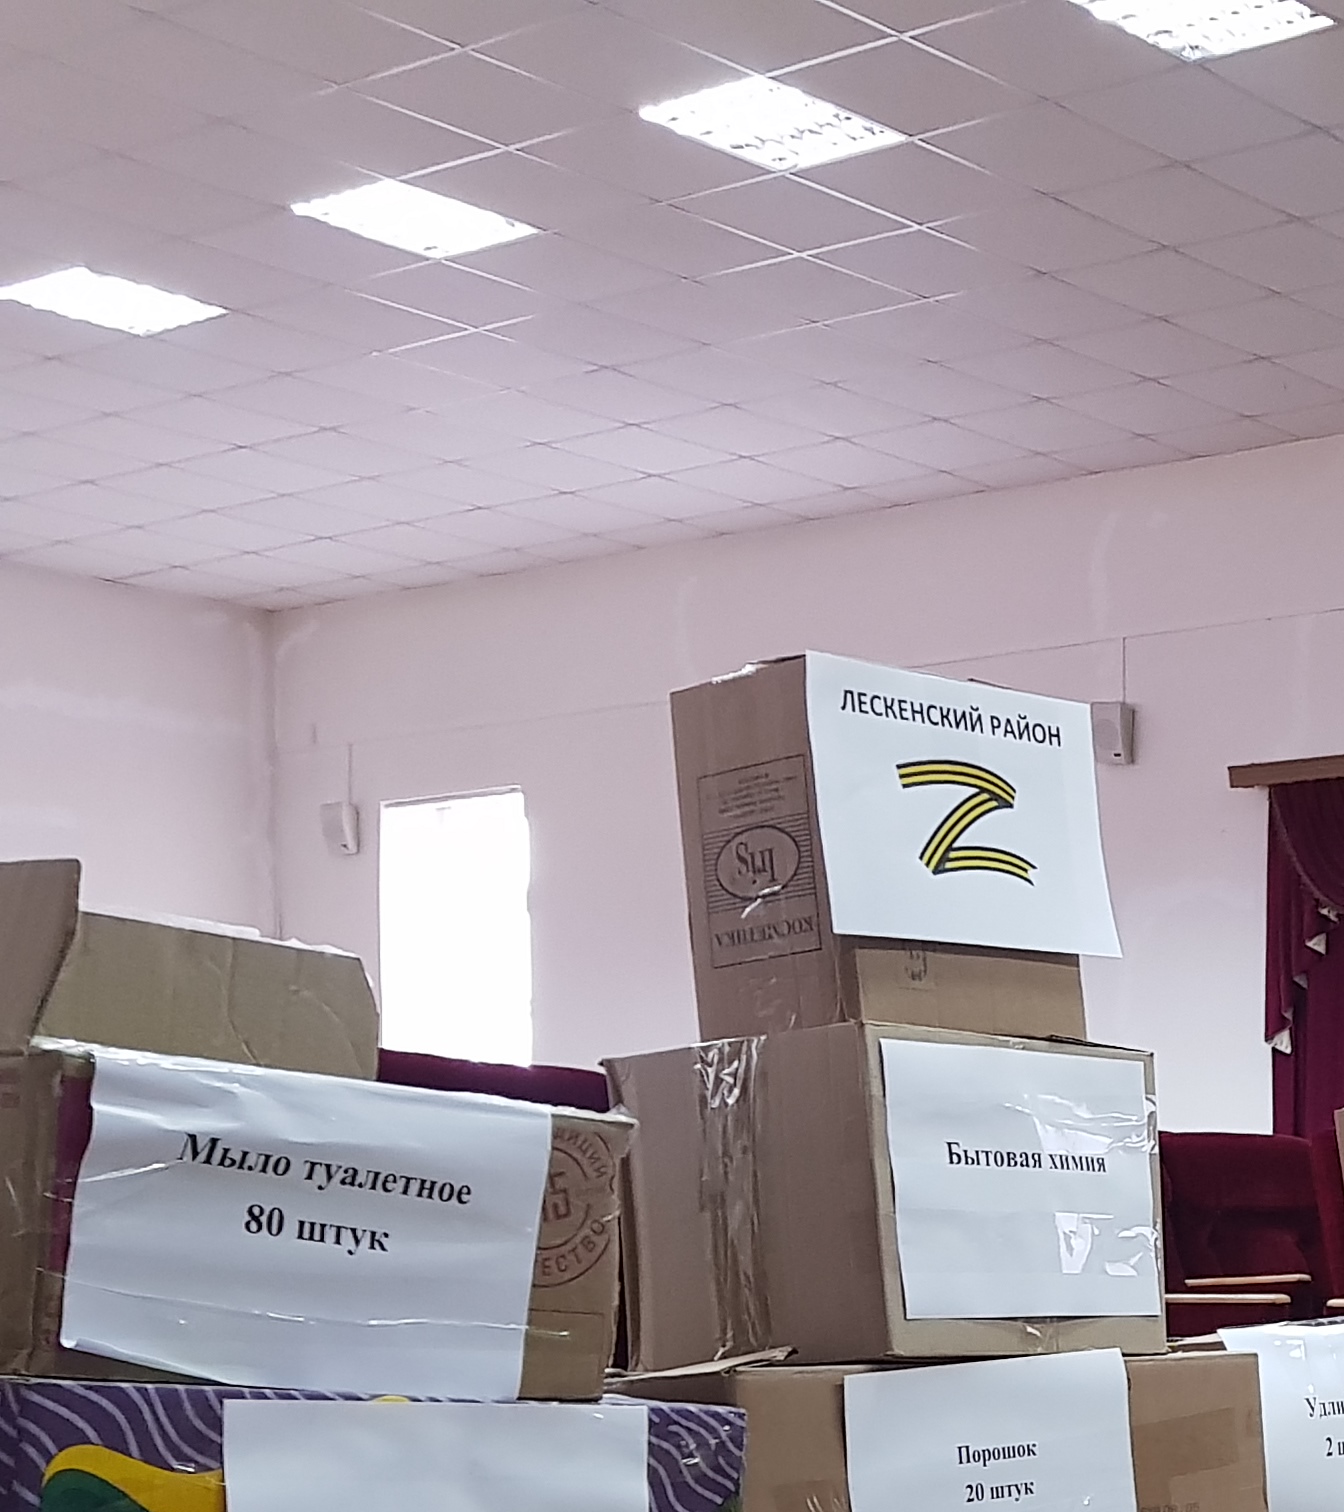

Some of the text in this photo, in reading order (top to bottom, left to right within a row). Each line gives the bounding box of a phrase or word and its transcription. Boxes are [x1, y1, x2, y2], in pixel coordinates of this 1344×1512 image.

[840, 689, 1061, 748] ЛЕСКЕНСКИЙ РАЙОН
[735, 841, 778, 885] Iris
[714, 914, 815, 949] КОСМЕТИКА
[175, 1132, 472, 1205] Мыло туалетное
[945, 1141, 1107, 1173] Бытовая химия
[244, 1203, 390, 1256] 80 штук
[956, 1443, 1037, 1468] Порошок
[1325, 1436, 1334, 1457] 2
[965, 1481, 1035, 1503] 20 штук
